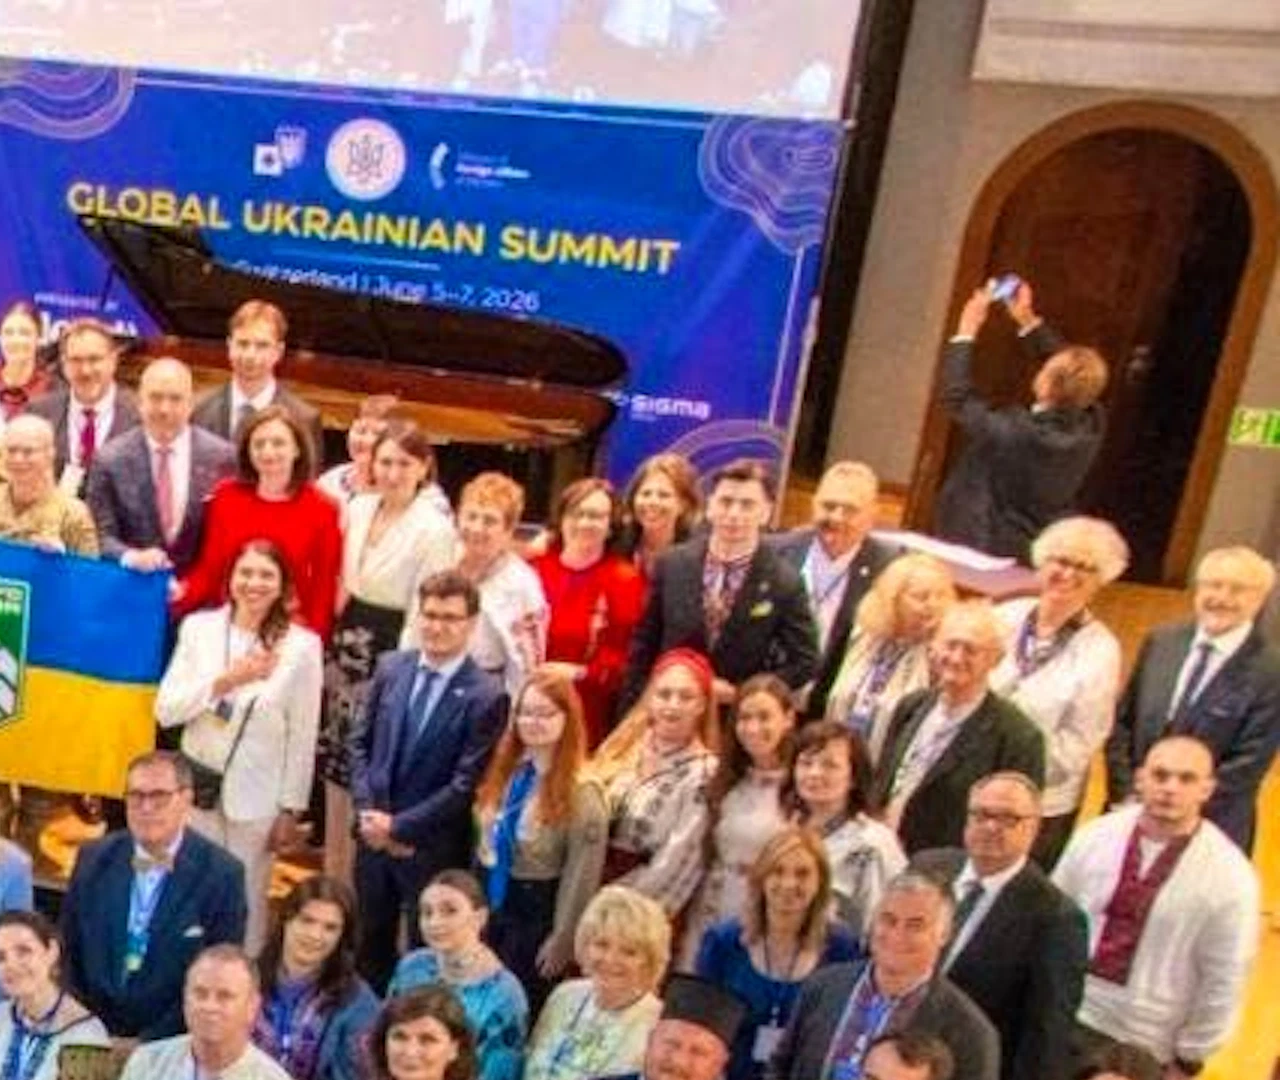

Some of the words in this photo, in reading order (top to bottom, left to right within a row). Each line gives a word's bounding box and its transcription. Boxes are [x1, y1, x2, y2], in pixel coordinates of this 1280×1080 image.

[67, 182, 230, 229] GLOBAL
[244, 200, 485, 255] UKRAINIAN
[499, 224, 682, 274] SUMMIT
[480, 287, 541, 313] 2026
